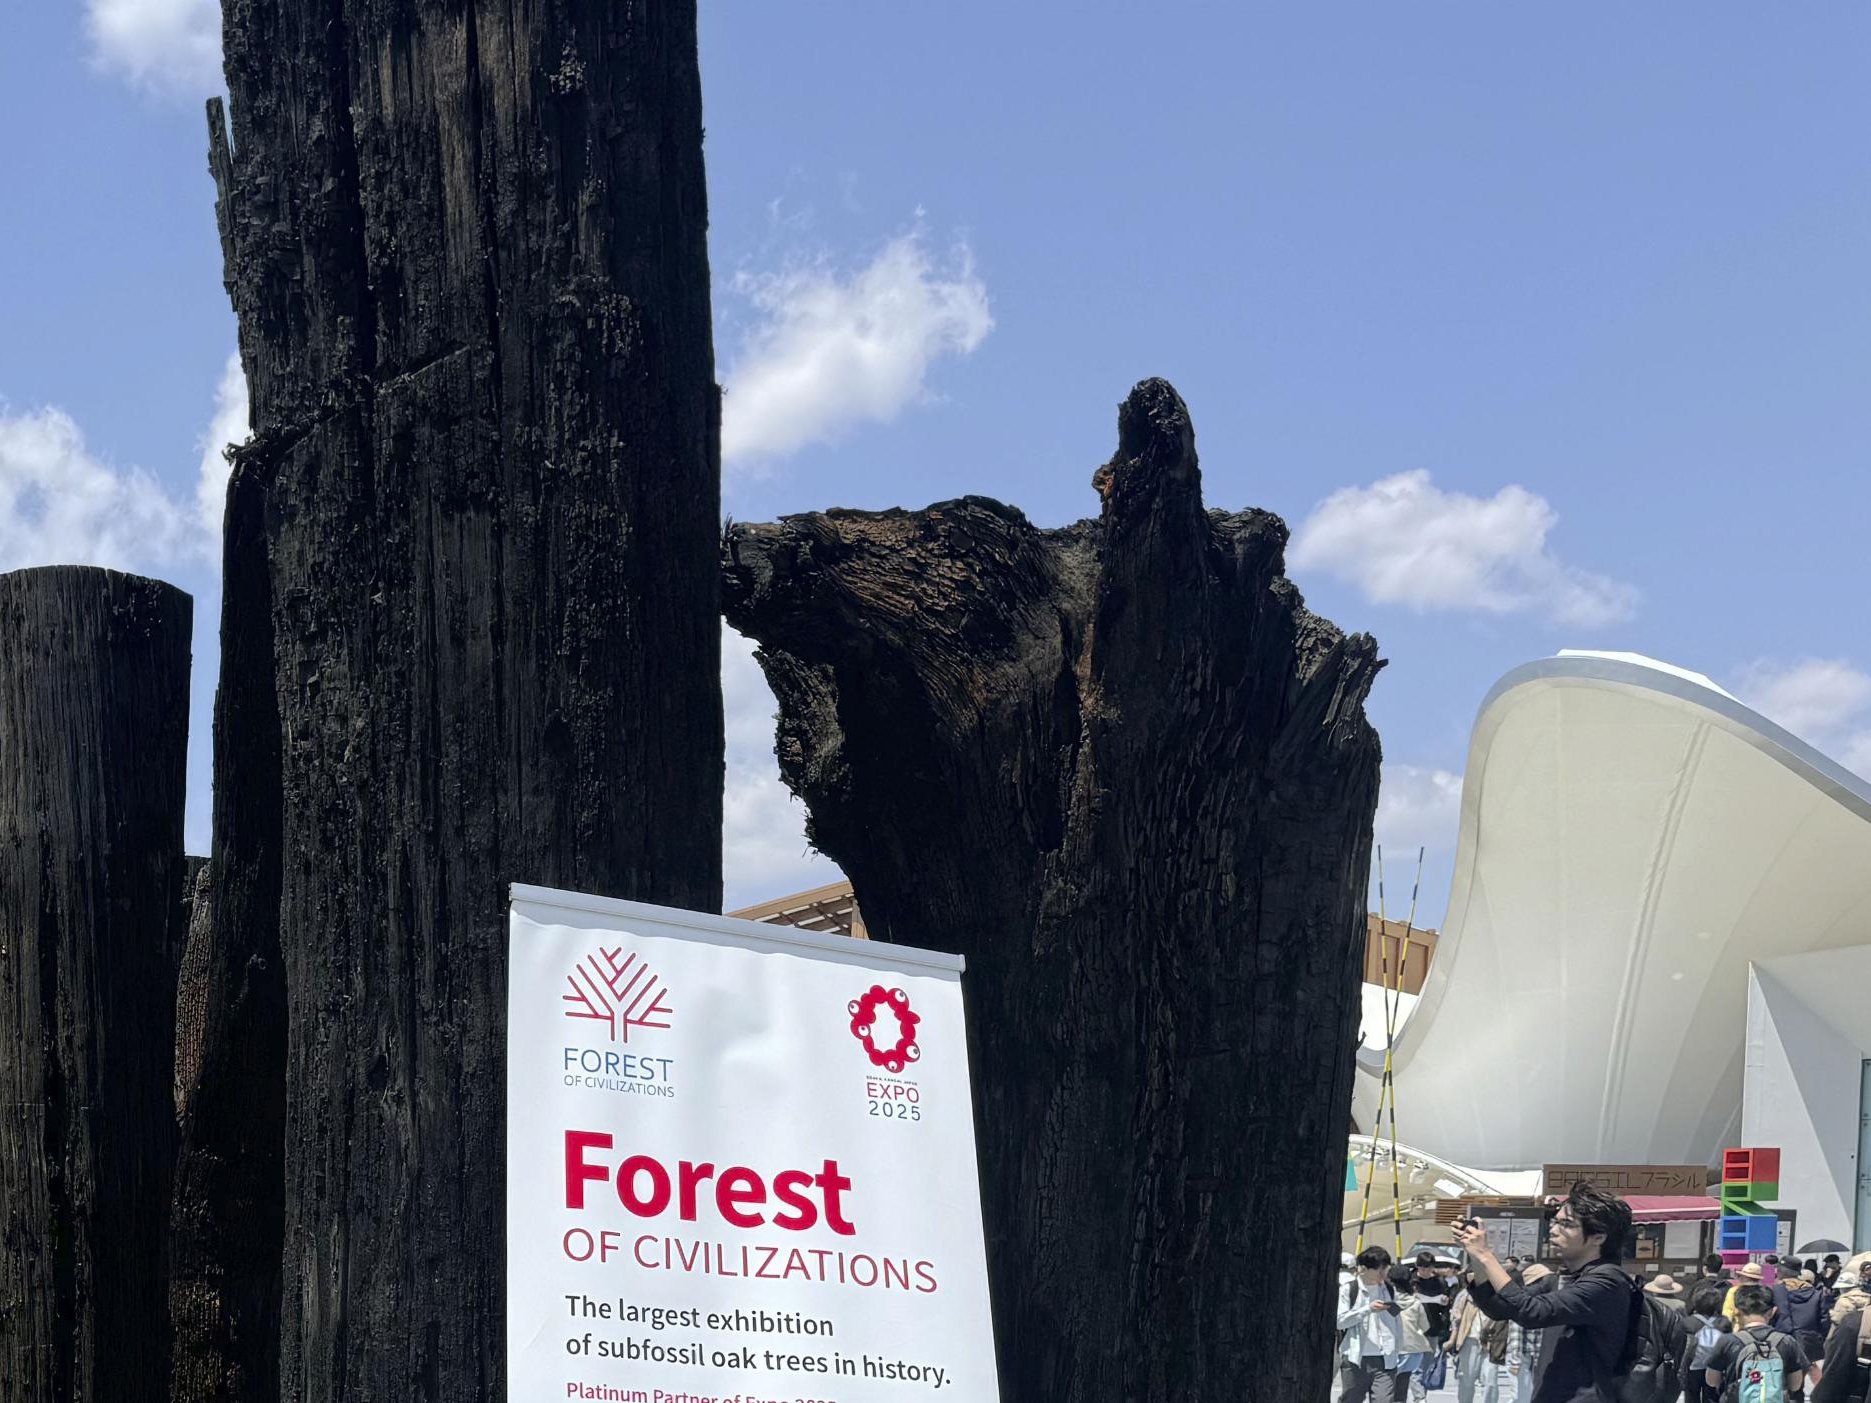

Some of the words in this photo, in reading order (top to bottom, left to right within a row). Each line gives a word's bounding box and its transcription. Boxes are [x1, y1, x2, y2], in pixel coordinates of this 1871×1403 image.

[564, 1047, 674, 1082] FOREST
[564, 1075, 582, 1086] OF
[585, 1077, 675, 1098] CIVILIZATIONS
[867, 1081, 920, 1104] EXPO
[869, 1100, 921, 1122] 2025
[564, 1129, 857, 1236] Forest
[563, 1227, 621, 1263] OF
[634, 1234, 938, 1293] CIVILIZATIONS
[565, 1294, 612, 1320] The
[619, 1298, 701, 1331] largest
[707, 1309, 834, 1337] exhibition
[566, 1333, 592, 1356] of
[598, 1336, 705, 1367] subfossil
[711, 1347, 757, 1370] oak
[763, 1350, 828, 1373] trees
[834, 1352, 856, 1376] in
[863, 1354, 951, 1389] history.
[566, 1382, 648, 1403] Platinum
